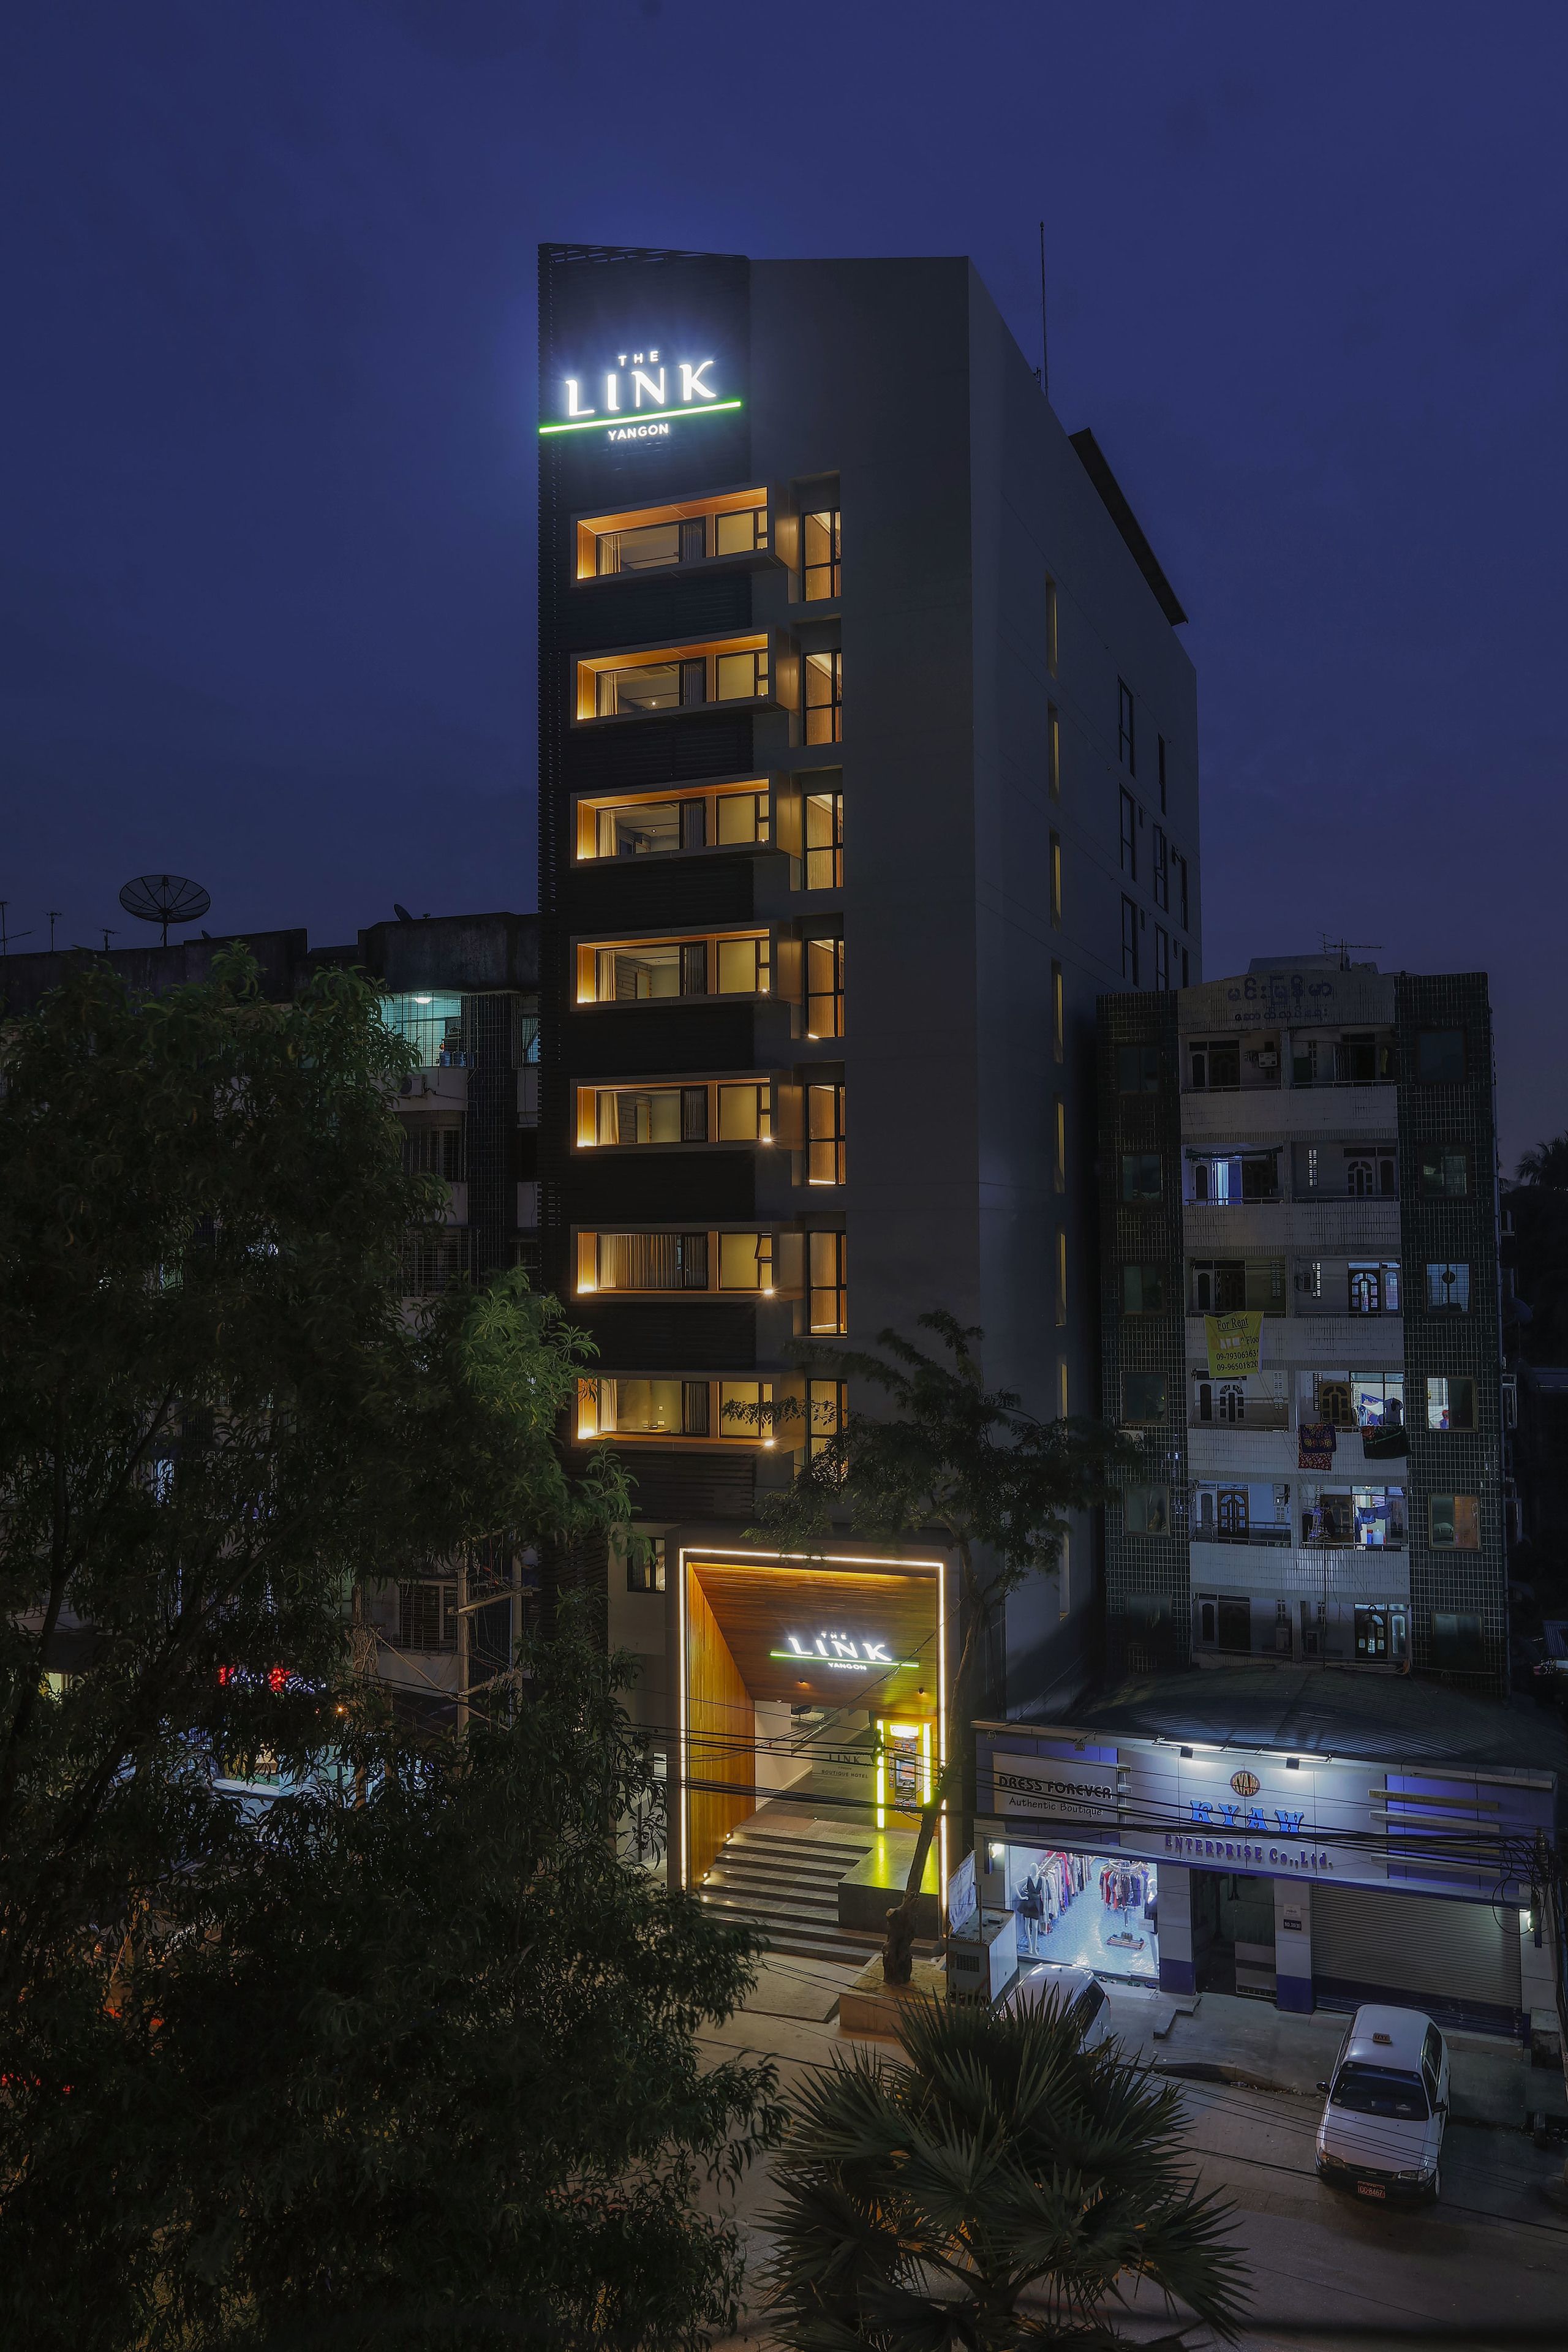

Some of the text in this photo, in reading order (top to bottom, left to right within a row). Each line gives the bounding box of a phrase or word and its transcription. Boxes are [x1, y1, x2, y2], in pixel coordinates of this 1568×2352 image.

[618, 350, 659, 366] THE
[565, 360, 717, 417] LINK
[608, 423, 669, 441] YANGON
[1216, 1317, 1249, 1330] For Rent
[821, 1631, 847, 1640] THE
[788, 1636, 892, 1660] LINK
[999, 1776, 1112, 1800] DRESS FOREVER
[1009, 1797, 1103, 1818] Authentic Boutique
[1190, 1800, 1305, 1834] KYAW
[1165, 1834, 1262, 1860] ENTERPRISE
